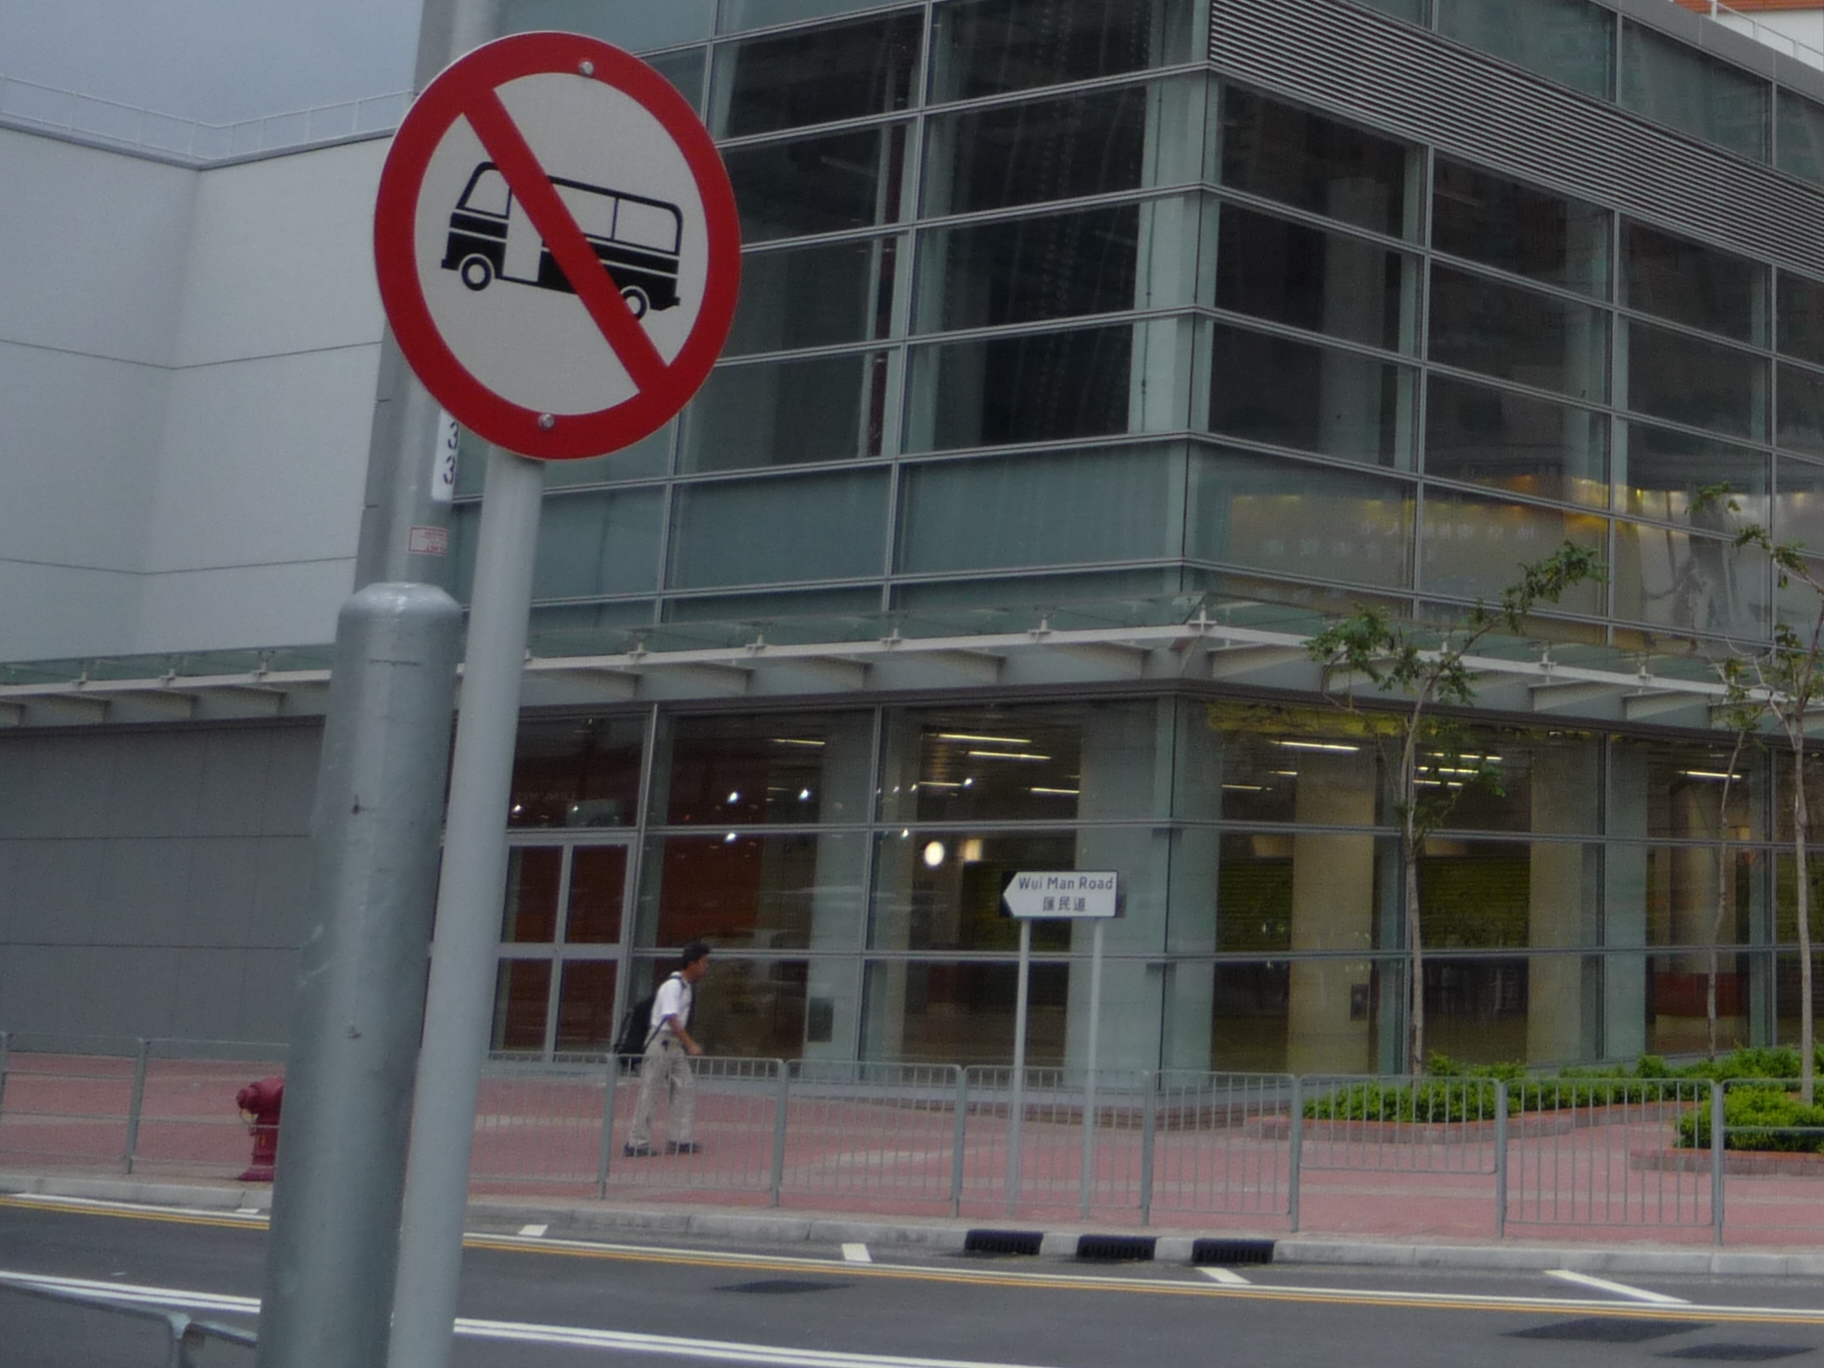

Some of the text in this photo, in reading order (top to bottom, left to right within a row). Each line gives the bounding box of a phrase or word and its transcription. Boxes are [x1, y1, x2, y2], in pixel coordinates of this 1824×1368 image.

[1018, 876, 1113, 890] Wui Man Road
